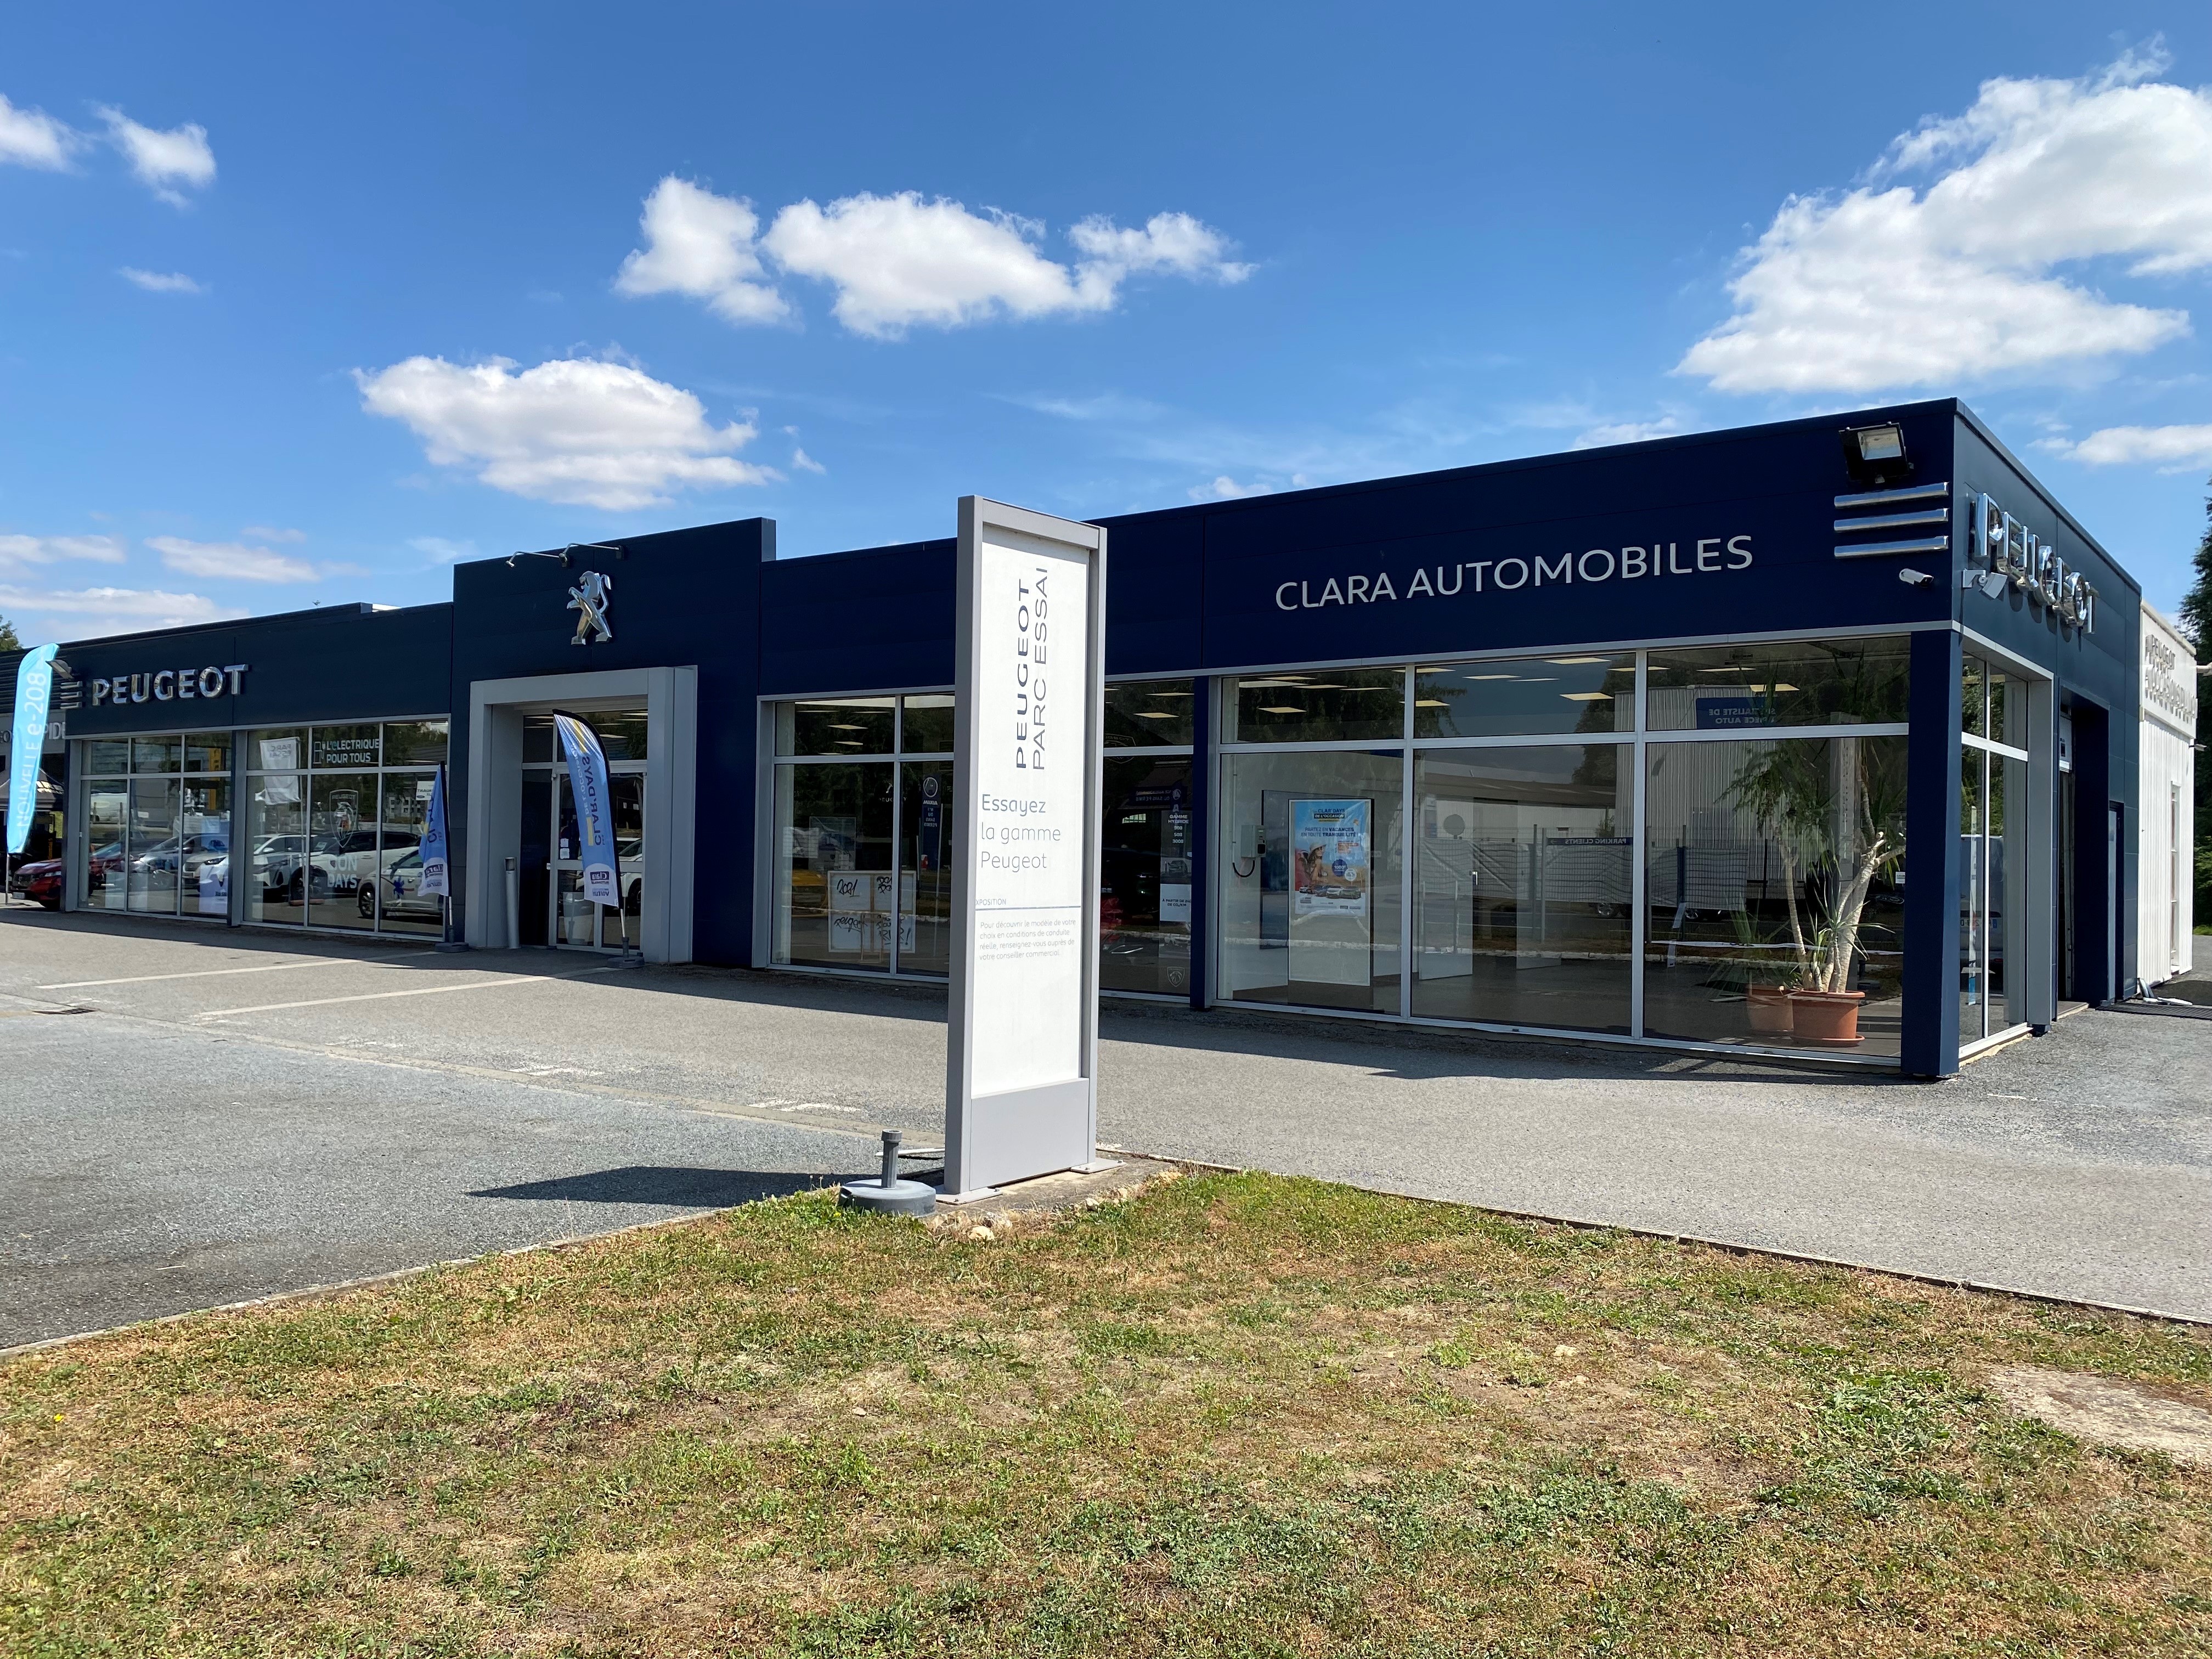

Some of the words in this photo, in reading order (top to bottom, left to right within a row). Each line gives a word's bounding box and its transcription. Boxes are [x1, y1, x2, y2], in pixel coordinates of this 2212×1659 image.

[1276, 572, 1397, 611] CLARA
[1406, 535, 1754, 599] AUTOMOBILES
[1035, 567, 1048, 665] ESSAI
[1016, 578, 1029, 769] PEUGEOT
[92, 664, 249, 706] PEUGEOT
[1032, 678, 1046, 770] PARC
[326, 753, 348, 763] POUR
[349, 752, 371, 763] TOUS
[982, 794, 1046, 817] Essayez
[981, 822, 995, 840] la
[1001, 828, 1061, 844] gamme
[981, 851, 1047, 873] Peugeot
[327, 873, 358, 889] DAYS
[980, 943, 998, 951] réelle,
[1000, 941, 1047, 950] renseignez-vous
[996, 951, 1025, 960] conseiller
